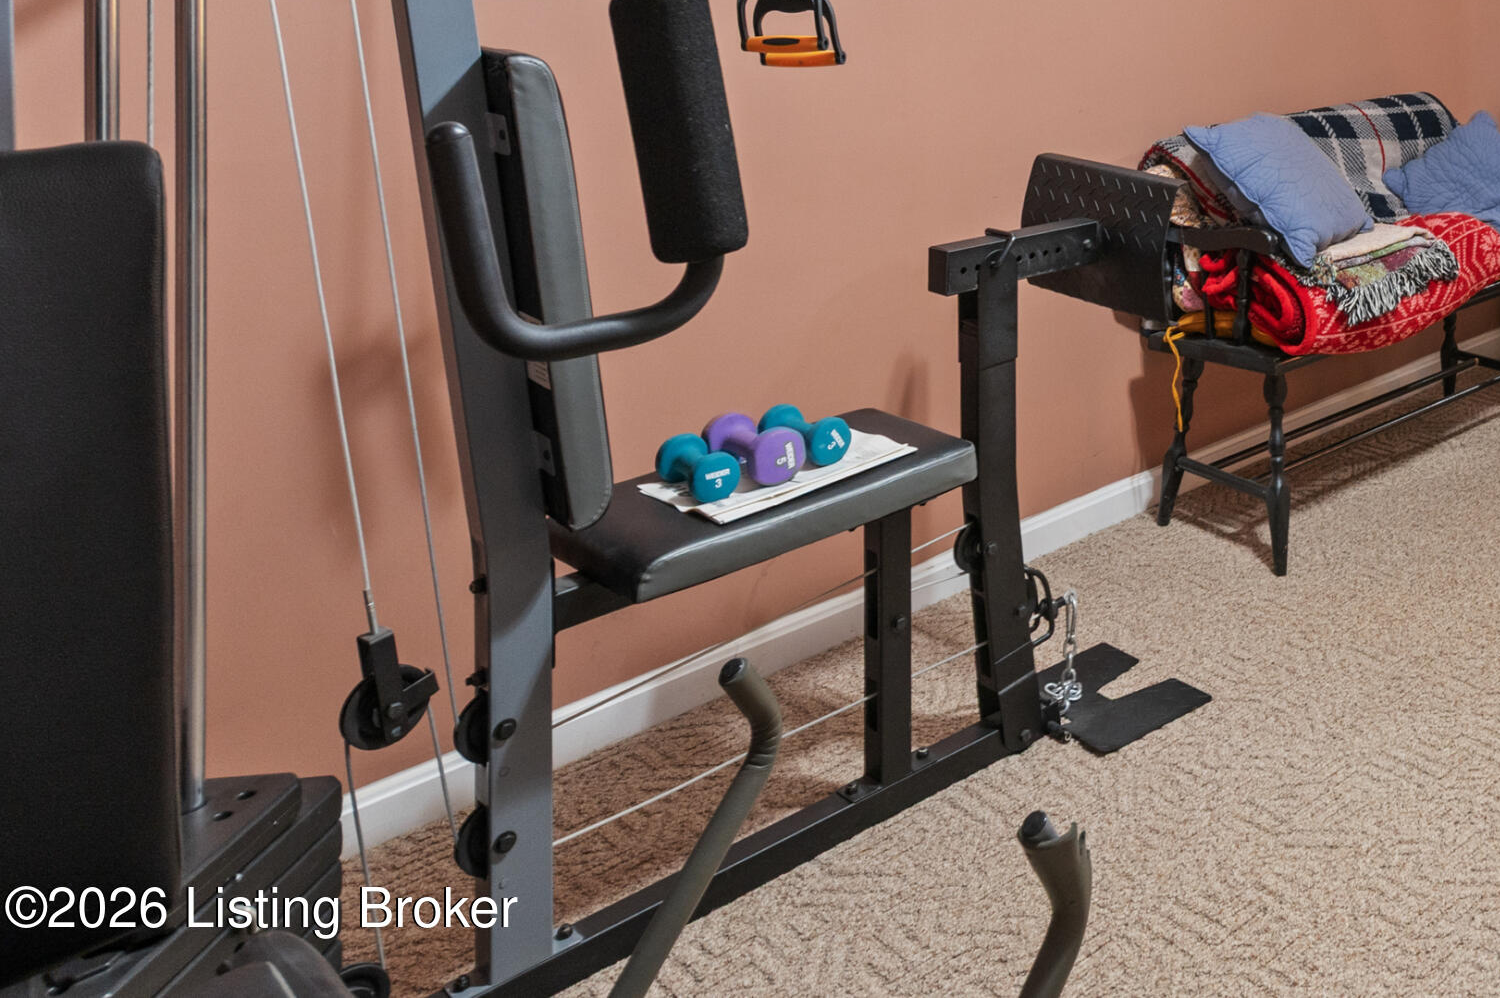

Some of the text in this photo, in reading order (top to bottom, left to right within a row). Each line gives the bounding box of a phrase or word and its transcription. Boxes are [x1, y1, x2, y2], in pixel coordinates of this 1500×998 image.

[785, 442, 795, 469] WEIDER
[705, 468, 730, 480] WEIDER
[715, 478, 722, 488] 3
